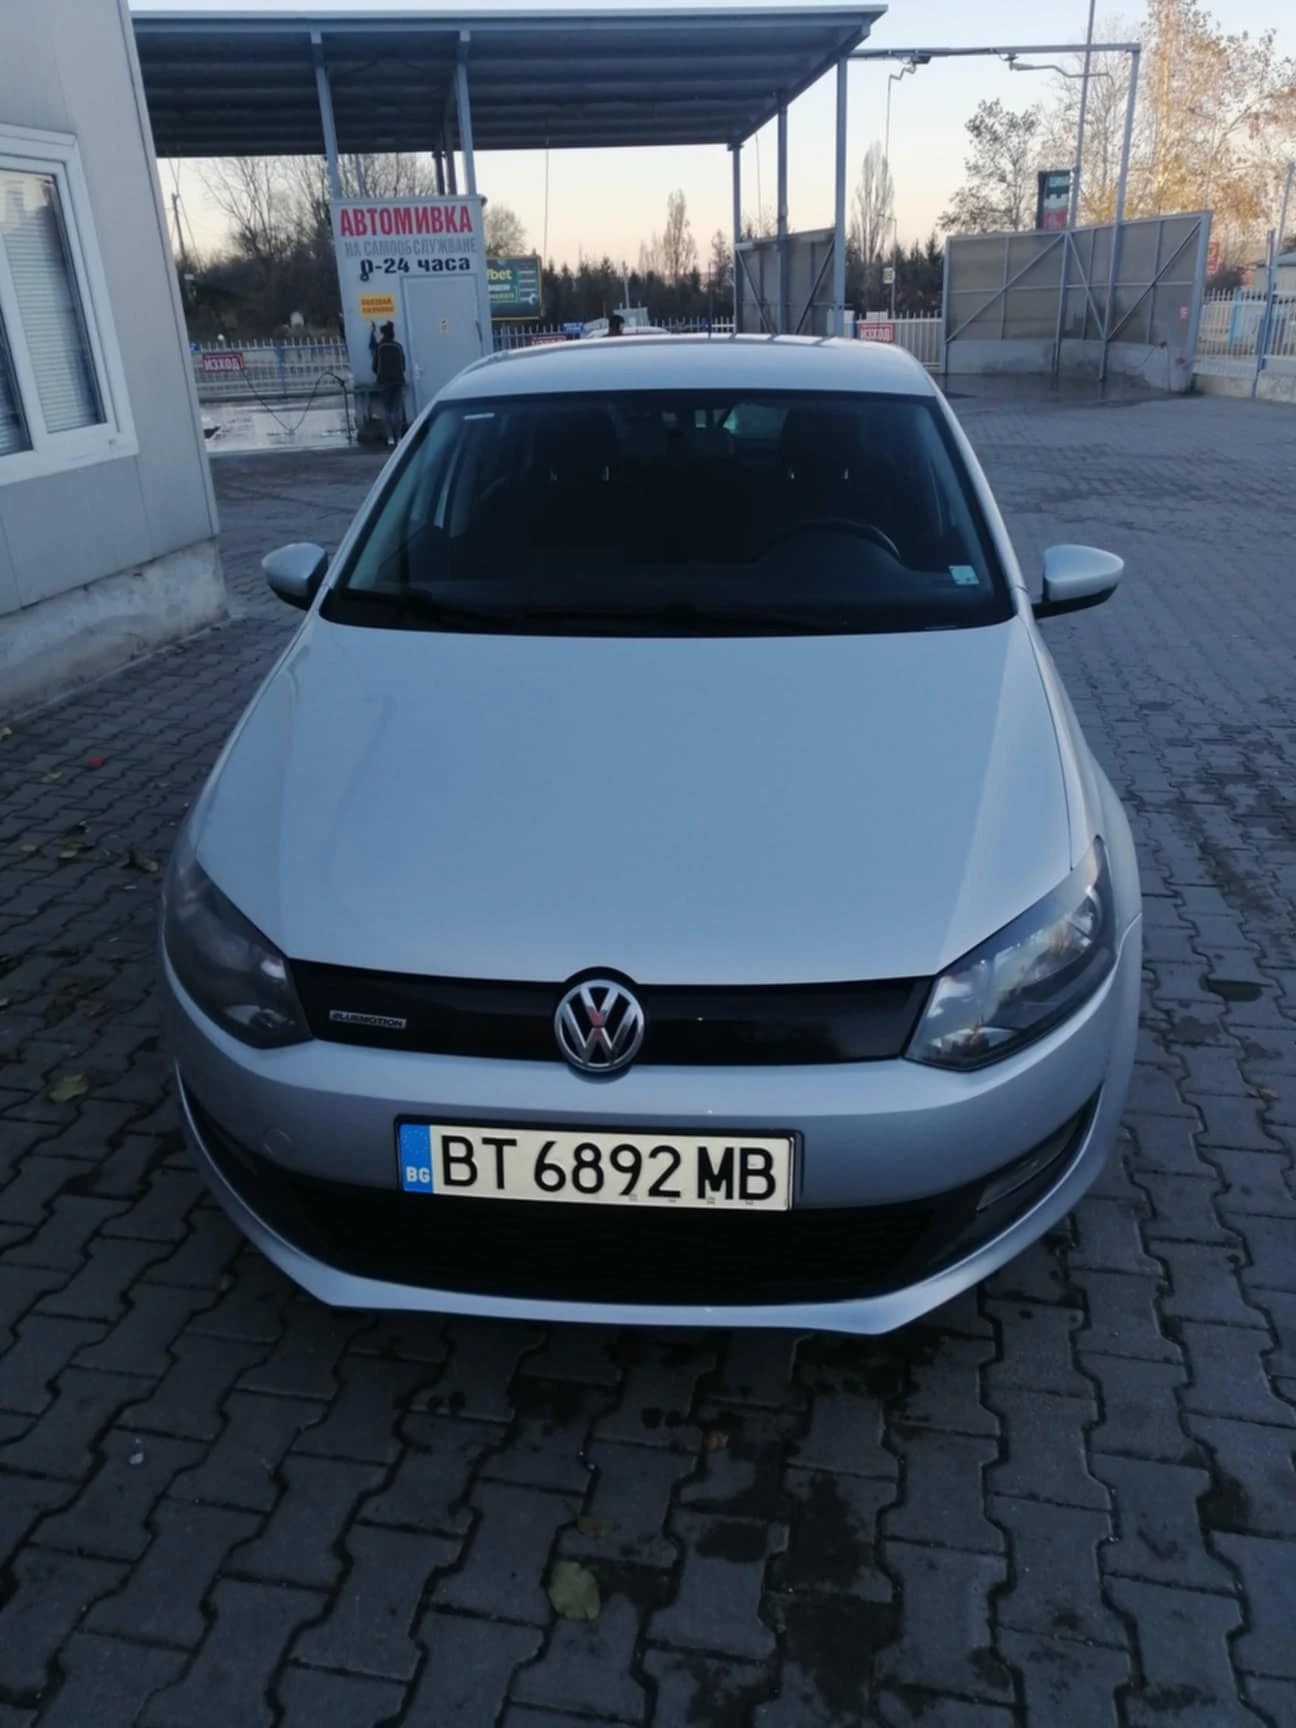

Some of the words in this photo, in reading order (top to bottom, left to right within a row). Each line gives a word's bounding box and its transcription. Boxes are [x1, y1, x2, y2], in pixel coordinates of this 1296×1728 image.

[340, 205, 473, 237] АВТОМИВКА
[417, 257, 471, 272] часа
[203, 357, 240, 371] ИЗХОД
[406, 1165, 431, 1184] BG
[441, 1134, 517, 1190] BT
[533, 1140, 682, 1198] 6892
[697, 1145, 777, 1202] MB
